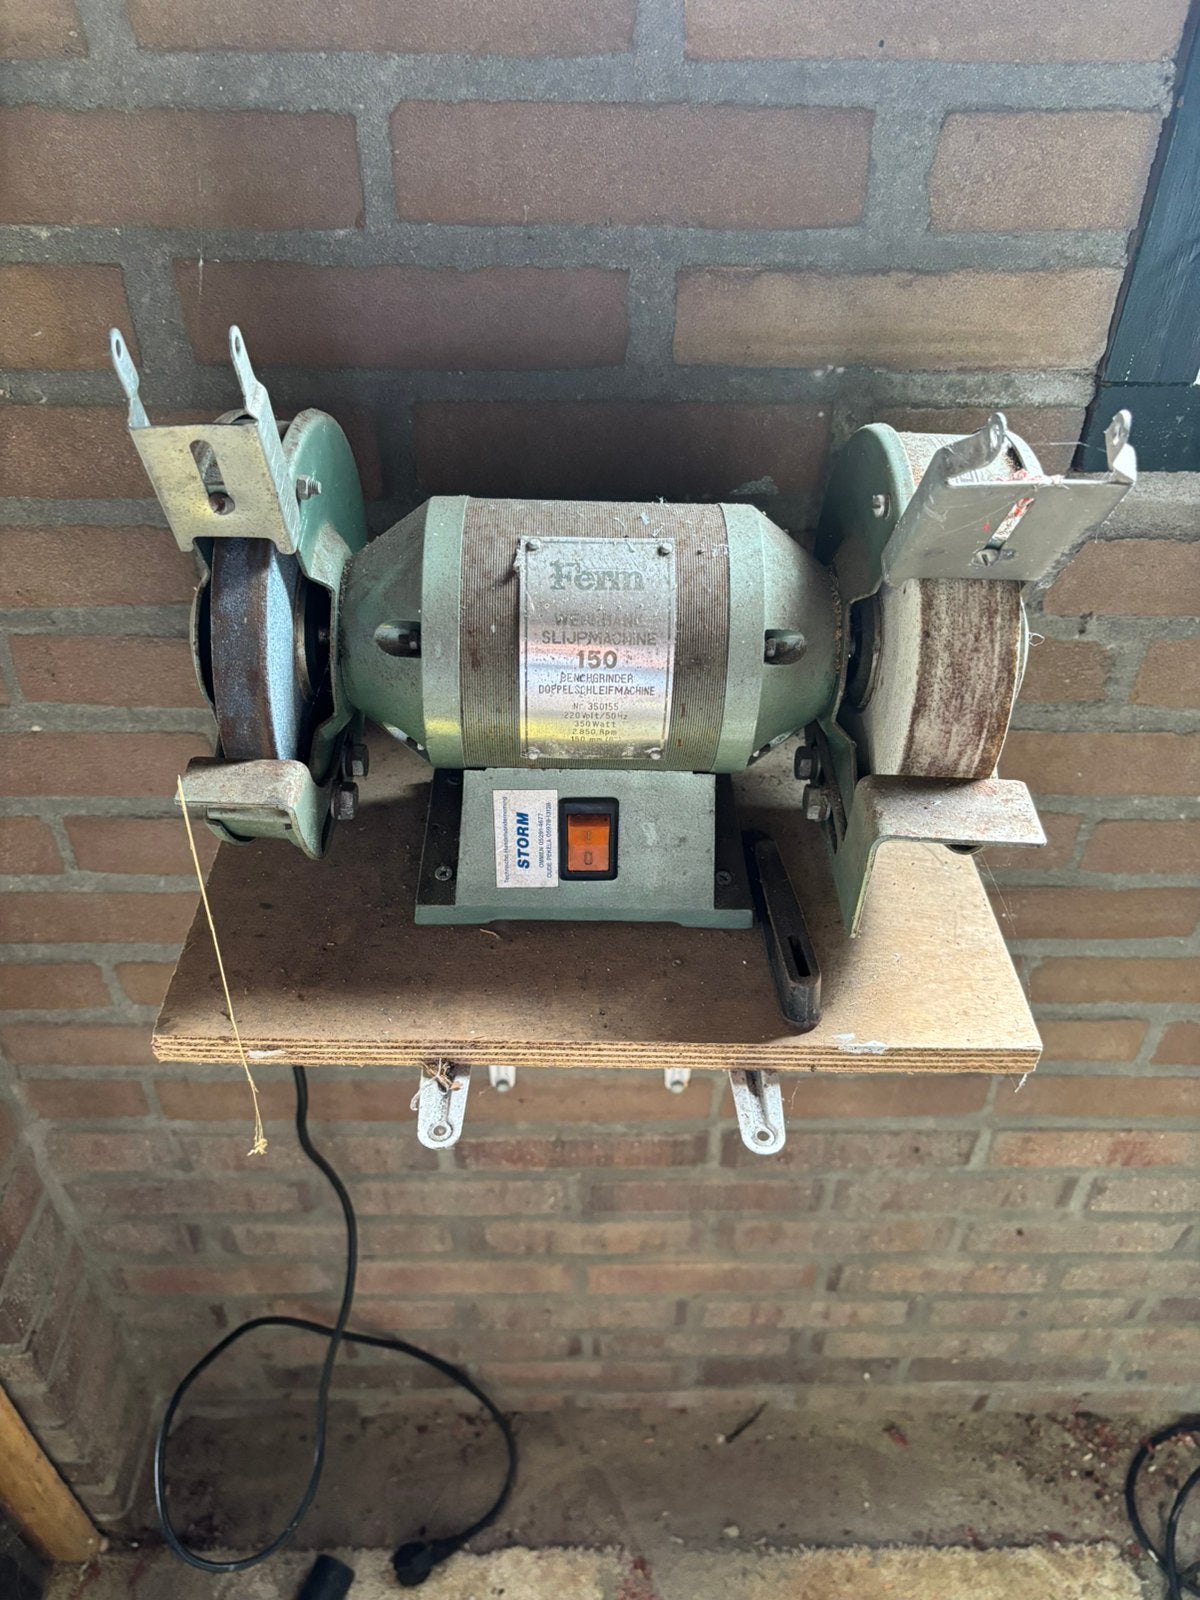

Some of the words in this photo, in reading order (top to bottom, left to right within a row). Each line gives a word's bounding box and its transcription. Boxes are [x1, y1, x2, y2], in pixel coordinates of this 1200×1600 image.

[549, 558, 645, 591] Ferm
[541, 630, 657, 646] SLIJPMACHINE
[576, 650, 618, 669] 150
[560, 672, 634, 684] BENCHGRINDER
[538, 684, 656, 696] DOPPELSCHLEIFMACHINE
[587, 702, 619, 711] 350155
[516, 812, 529, 869] STORM
